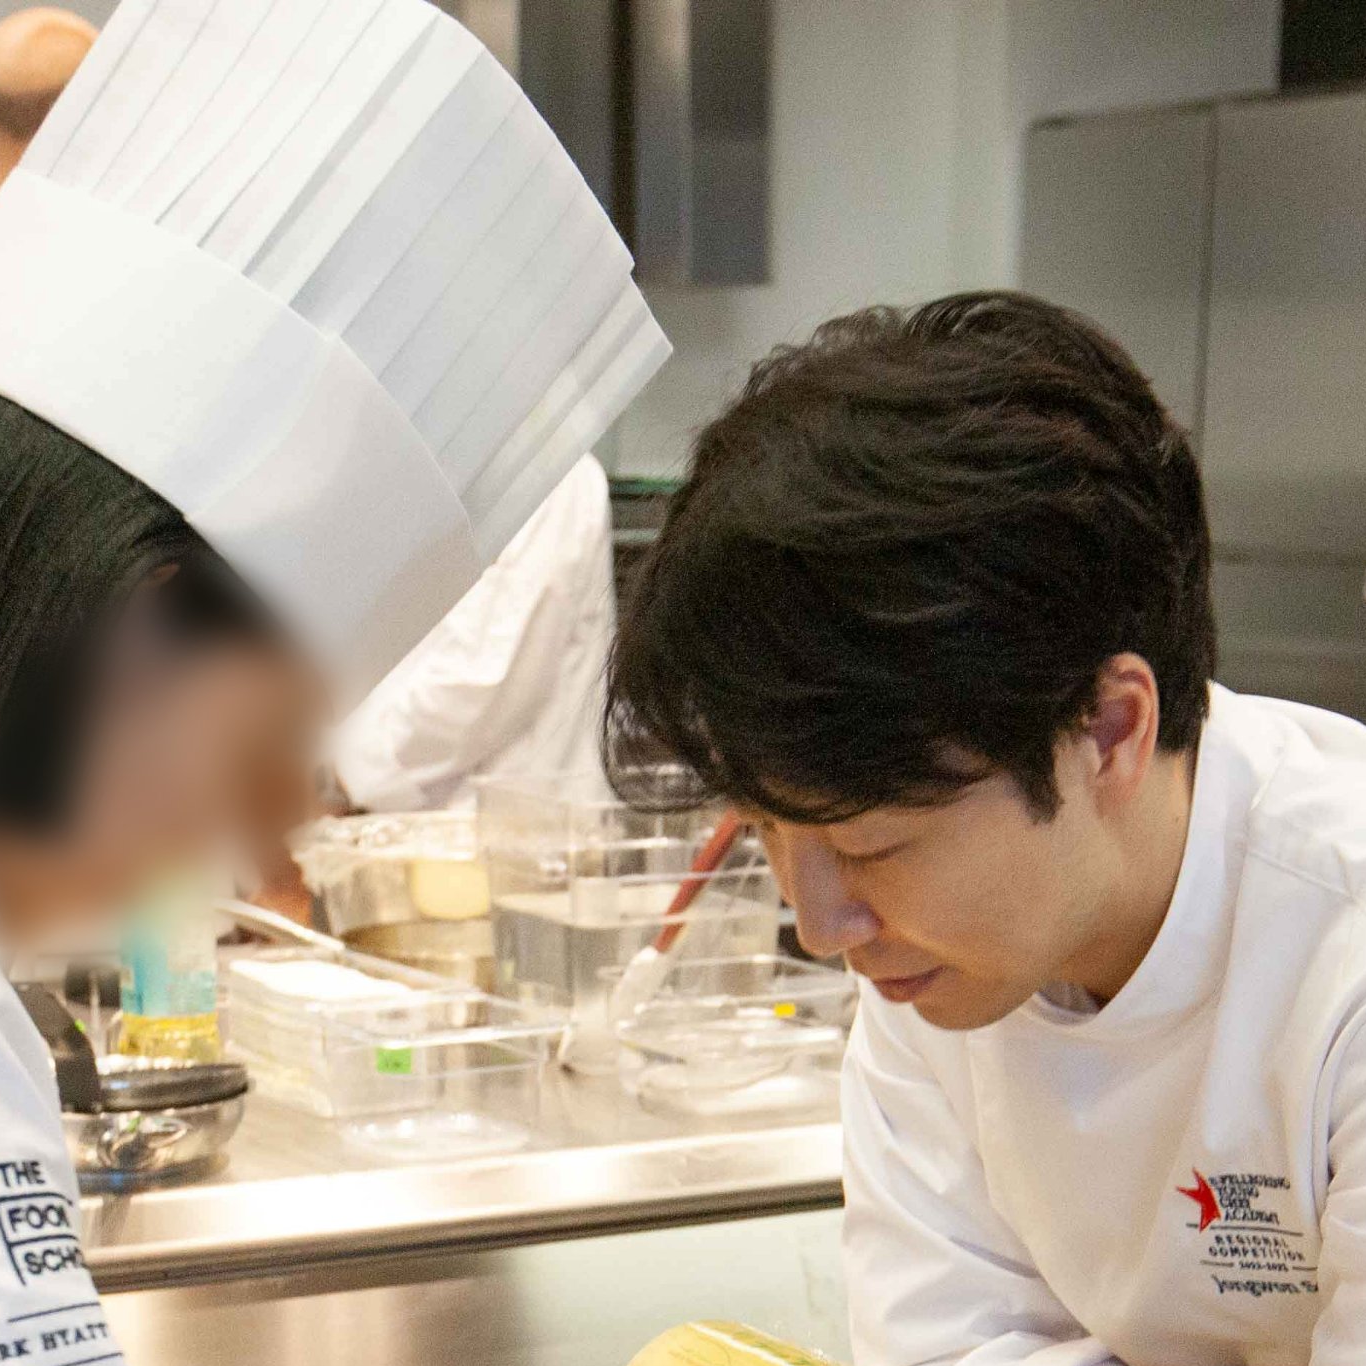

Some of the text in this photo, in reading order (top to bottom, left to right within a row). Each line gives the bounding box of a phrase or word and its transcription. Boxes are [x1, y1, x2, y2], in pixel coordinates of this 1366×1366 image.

[1215, 1234, 1289, 1249] REGIONAL
[1208, 1246, 1306, 1263] COMPETITION
[40, 1322, 109, 1351] HYATT
